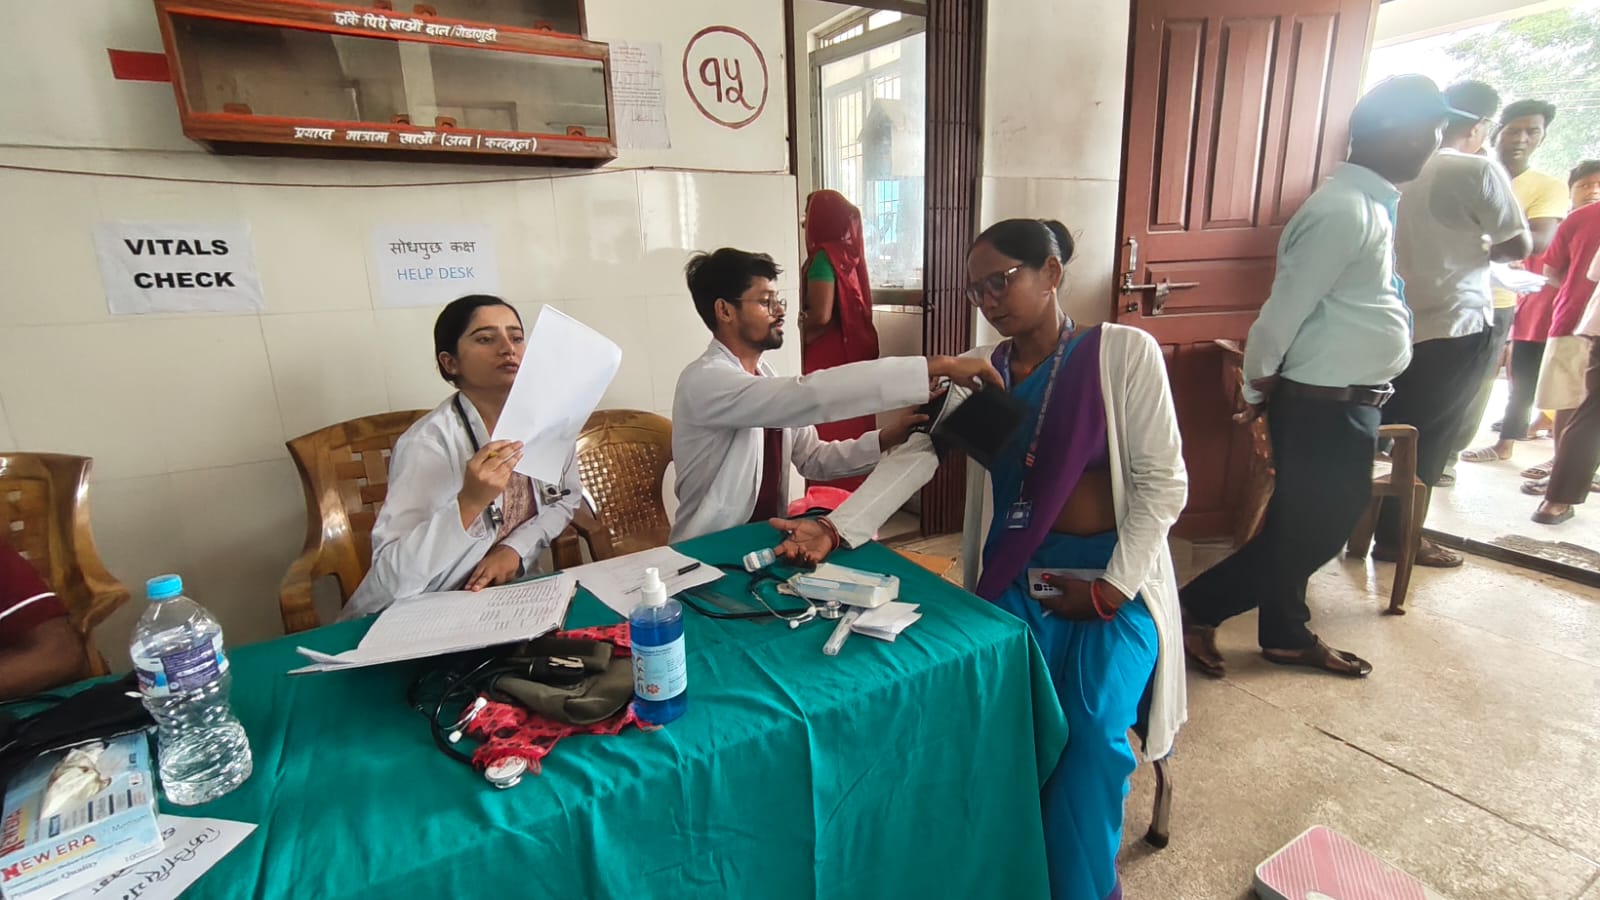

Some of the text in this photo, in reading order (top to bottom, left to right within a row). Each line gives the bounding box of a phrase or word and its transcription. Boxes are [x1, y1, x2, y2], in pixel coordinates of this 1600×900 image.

[123, 239, 229, 255] VITALS
[388, 238, 476, 260] सोधपुछ कक्ष
[134, 272, 236, 289] CHECK
[397, 266, 475, 281] HELP DESK
[1, 849, 51, 882] NEW
[55, 834, 96, 856] ERA
